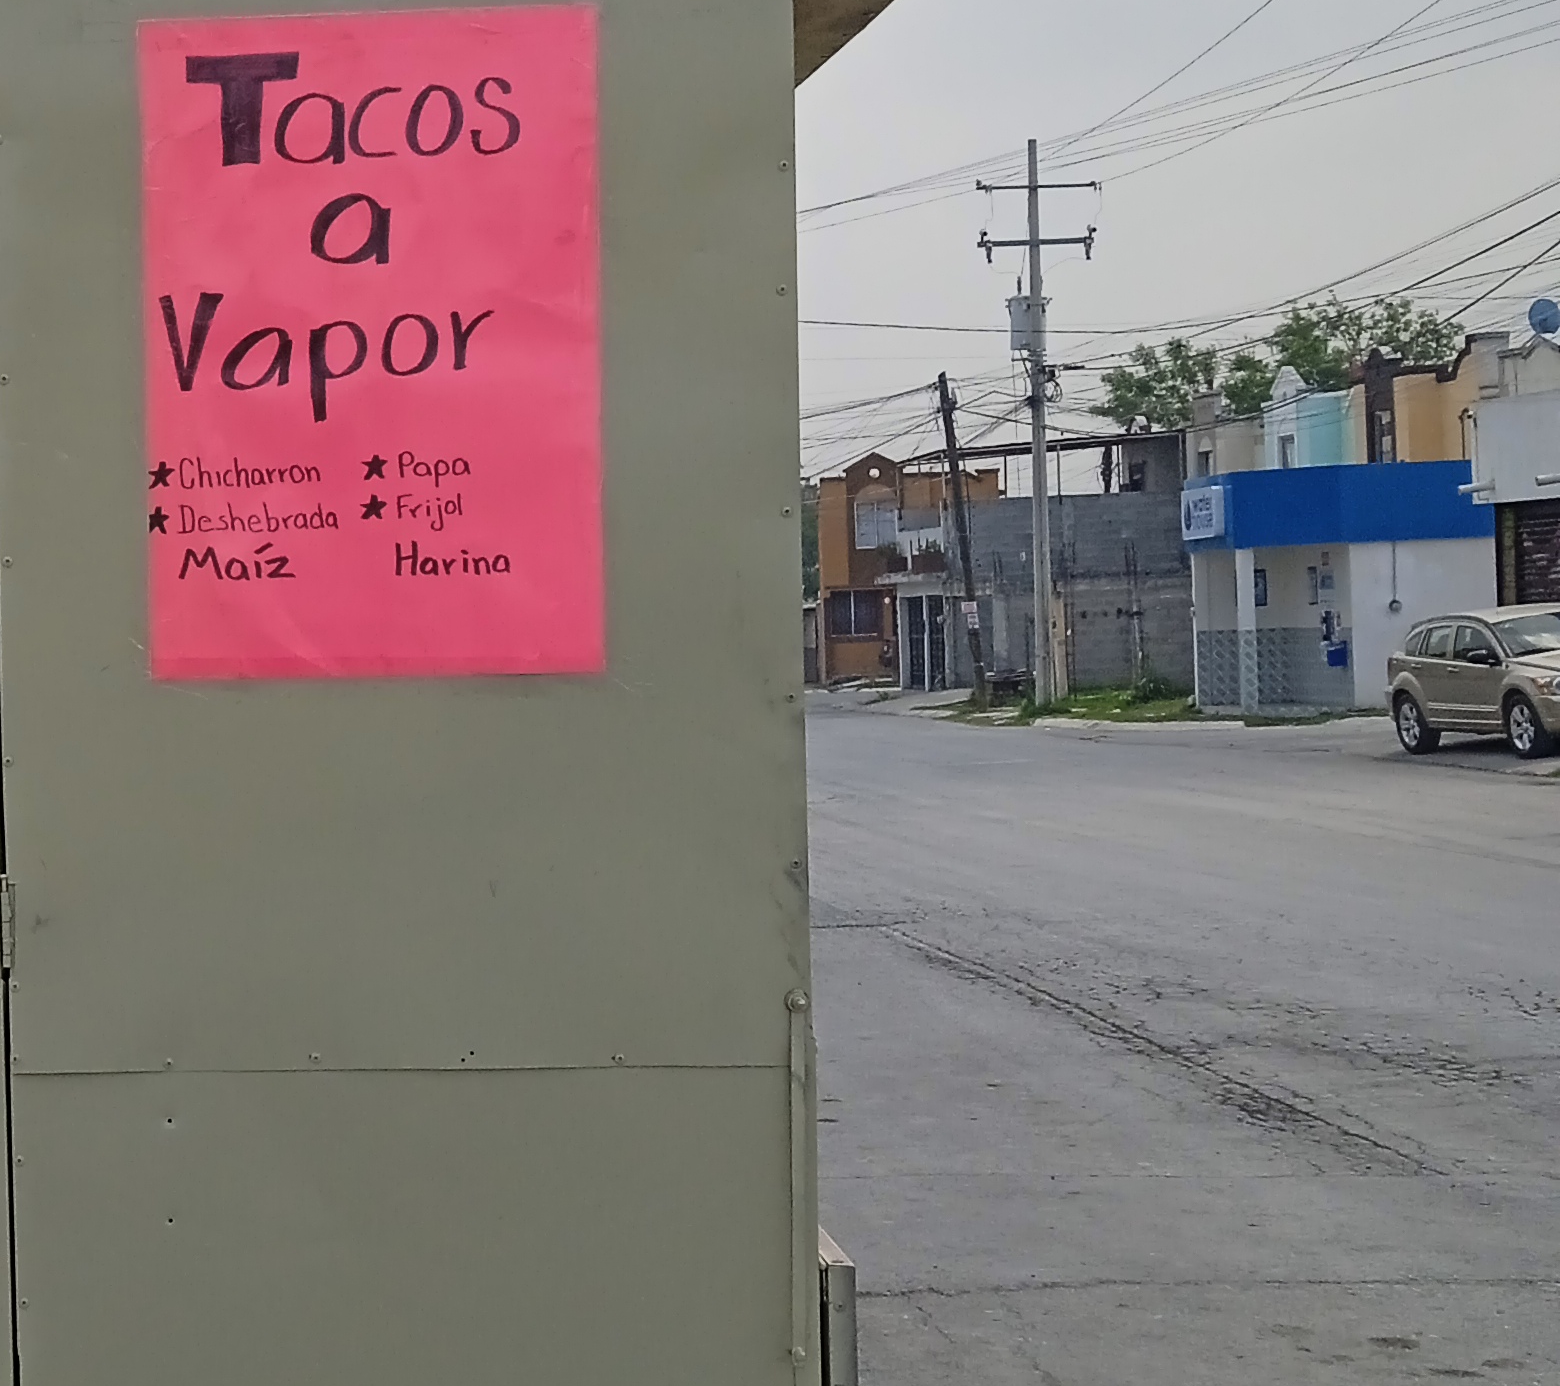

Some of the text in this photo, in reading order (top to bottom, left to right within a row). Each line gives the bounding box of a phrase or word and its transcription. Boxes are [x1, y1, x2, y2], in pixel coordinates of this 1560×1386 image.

[185, 51, 521, 167] Tacos
[310, 192, 391, 266] a
[158, 291, 496, 424] Vapor
[179, 450, 471, 490] Chicharron Papa
[176, 492, 463, 535] Deshebrada Frijol
[178, 540, 511, 581] Maíz Harina
